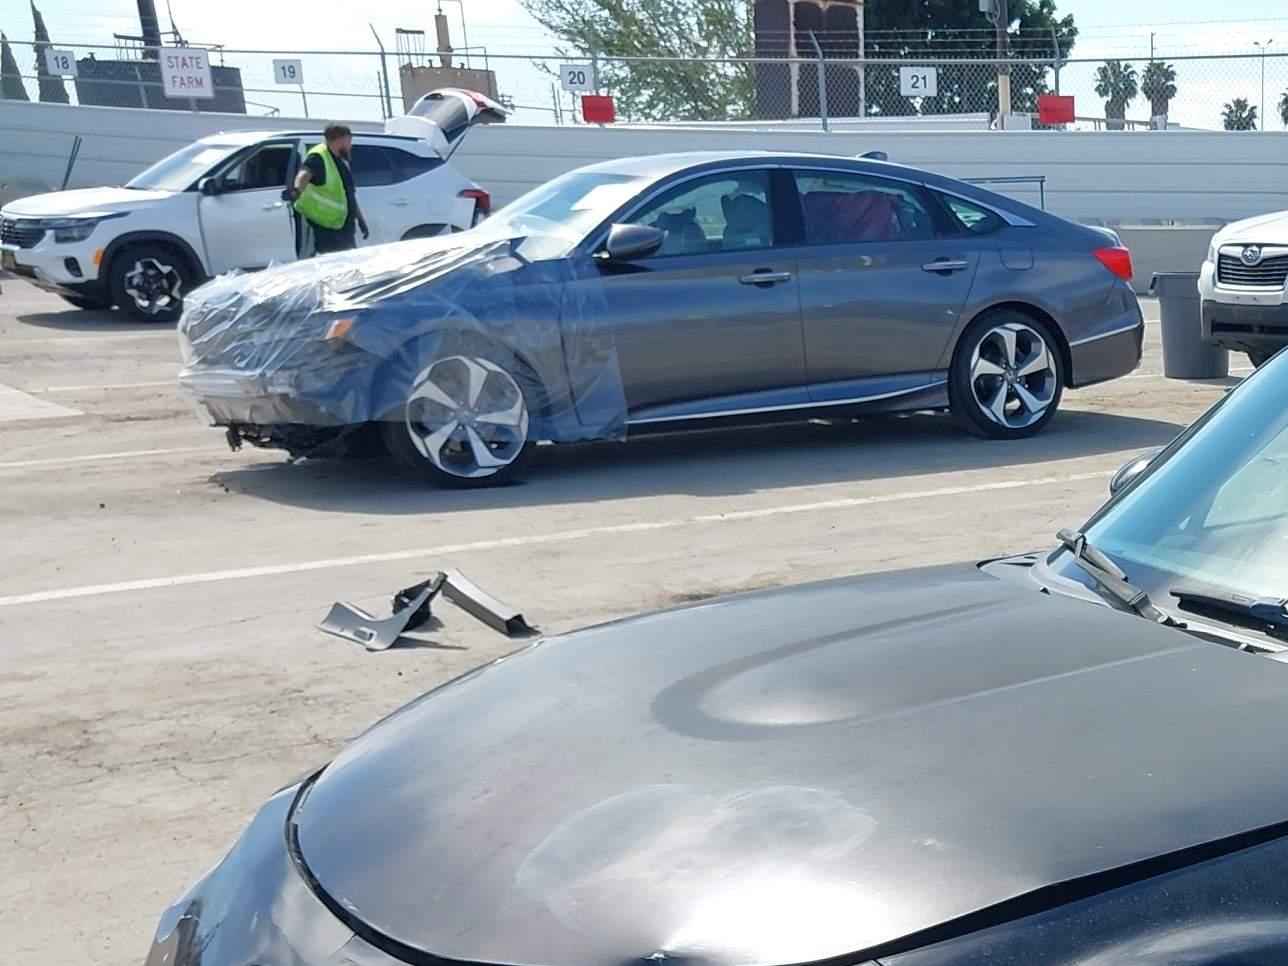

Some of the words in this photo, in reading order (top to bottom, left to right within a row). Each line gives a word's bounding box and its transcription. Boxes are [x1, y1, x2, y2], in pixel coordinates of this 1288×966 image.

[53, 55, 69, 70] 18
[167, 55, 204, 70] STATE
[281, 64, 296, 79] 19
[568, 71, 586, 85] 20
[172, 75, 204, 90] FARM
[910, 74, 928, 89] 21
